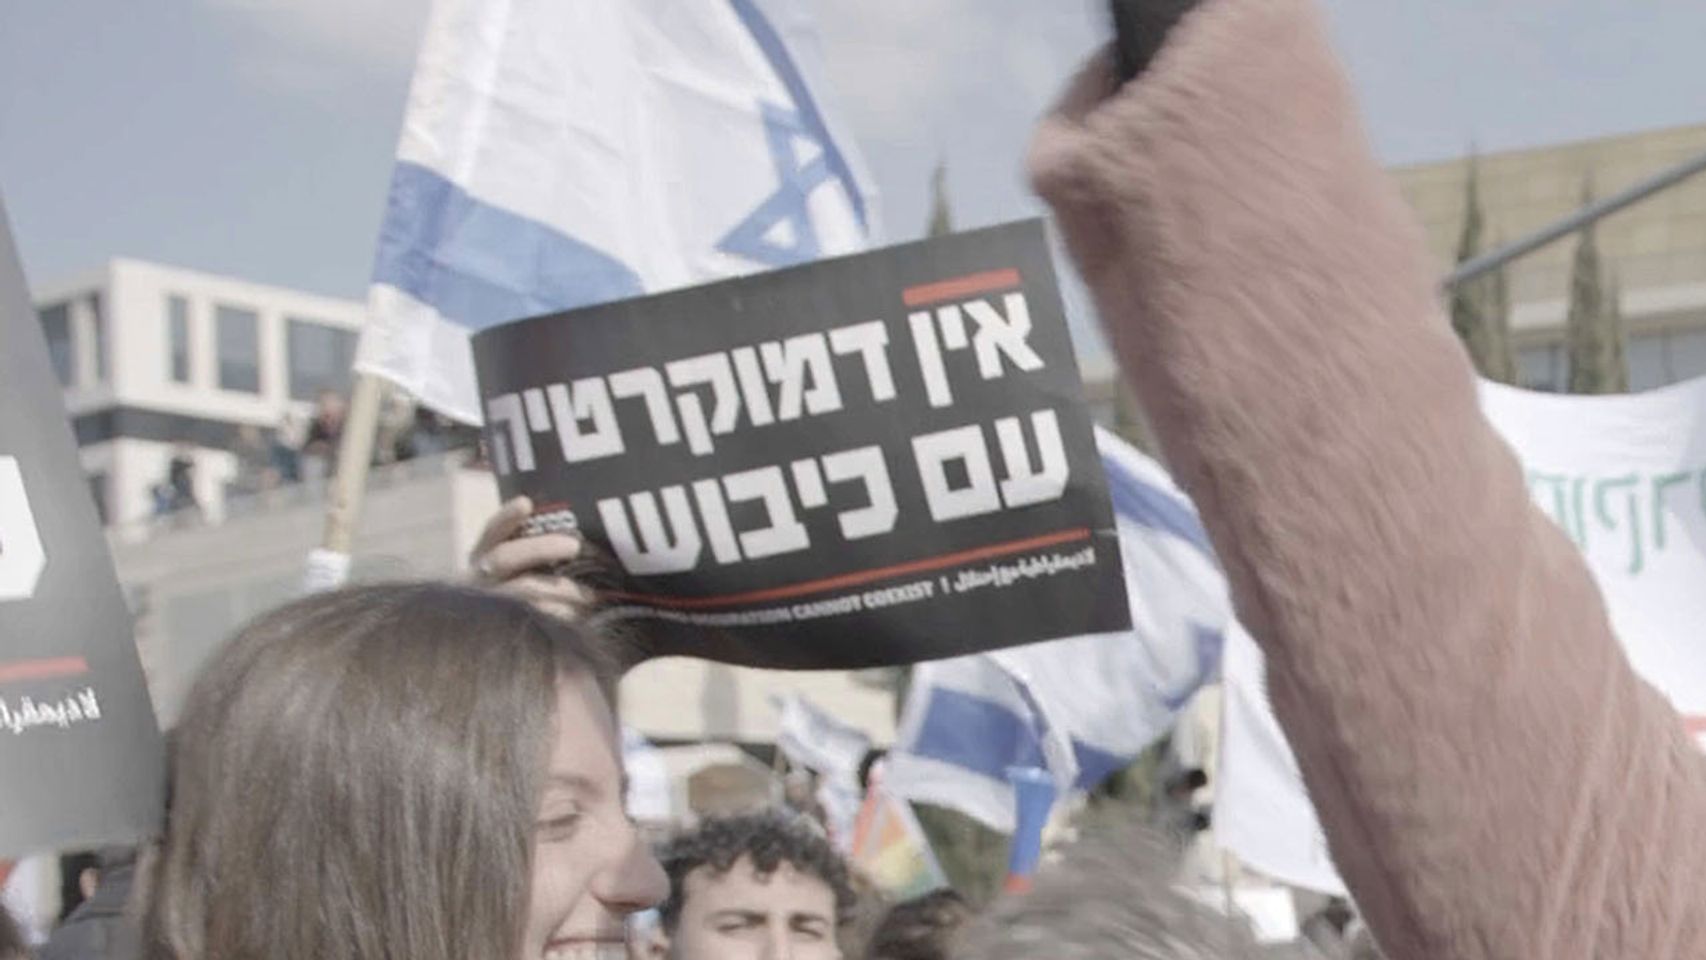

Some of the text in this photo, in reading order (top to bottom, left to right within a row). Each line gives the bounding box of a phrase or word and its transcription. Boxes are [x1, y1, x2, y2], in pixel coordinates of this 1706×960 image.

[487, 293, 1045, 475] אין דמוקרטיה
[598, 409, 1069, 576] עם כיבוש
[862, 581, 934, 610] COEXIST
